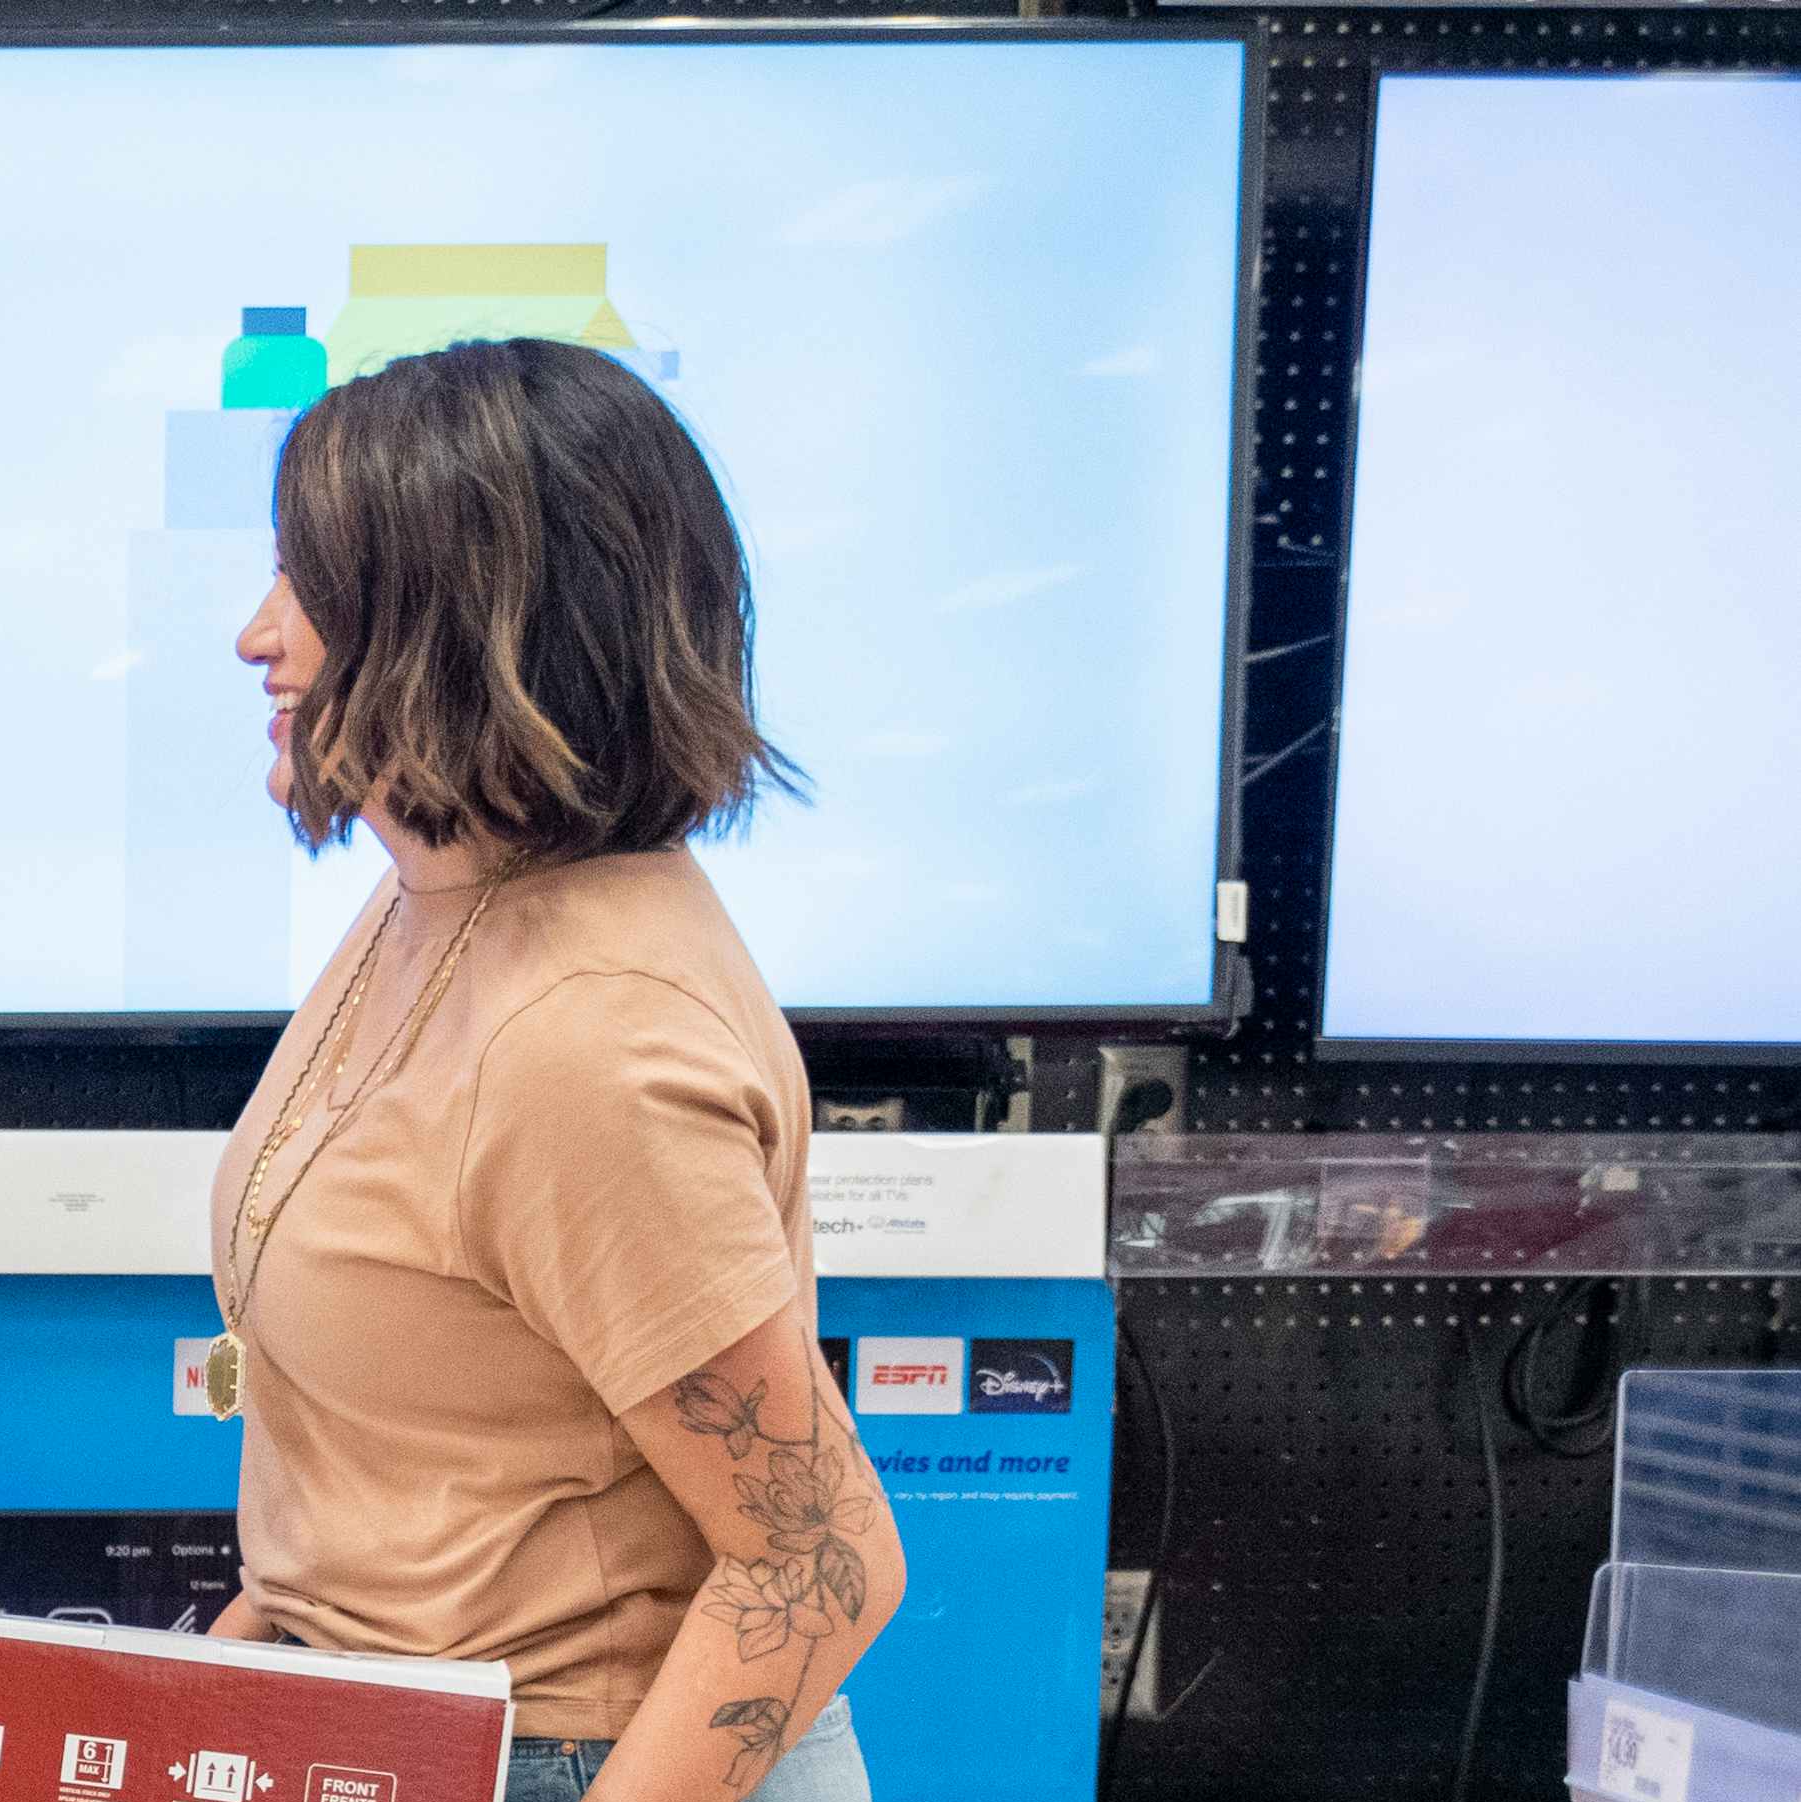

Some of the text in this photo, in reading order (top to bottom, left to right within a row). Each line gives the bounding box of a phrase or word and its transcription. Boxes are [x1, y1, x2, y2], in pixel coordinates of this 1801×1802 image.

[870, 1364, 950, 1387] ESPN
[873, 1450, 1071, 1475] vies and more
[82, 1742, 97, 1759] 6
[78, 1764, 100, 1776] MAX
[322, 1778, 380, 1797] FRONT
